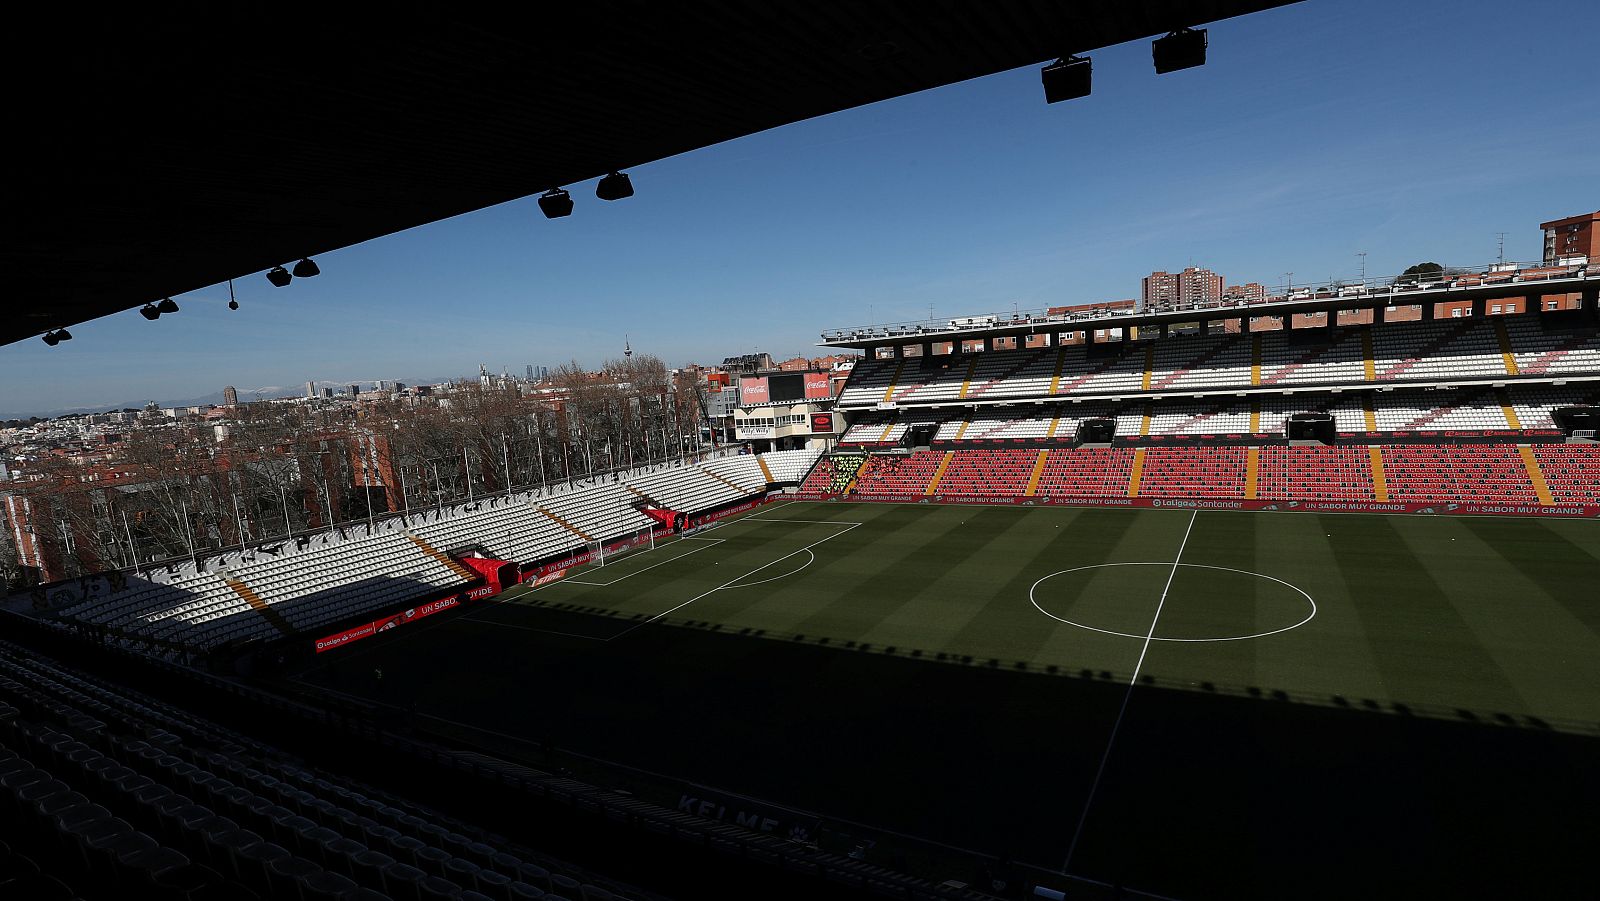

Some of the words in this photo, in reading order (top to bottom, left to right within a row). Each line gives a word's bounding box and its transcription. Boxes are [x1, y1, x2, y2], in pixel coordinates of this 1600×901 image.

[1162, 499, 1188, 508] LaLiga
[1197, 500, 1243, 508] Santander
[1481, 505, 1515, 513] SABOR
[1541, 506, 1584, 514] GRANDE
[557, 558, 577, 569] SABOR
[421, 605, 433, 614] UN
[324, 638, 341, 648] LaLiga
[349, 626, 373, 639] Santander
